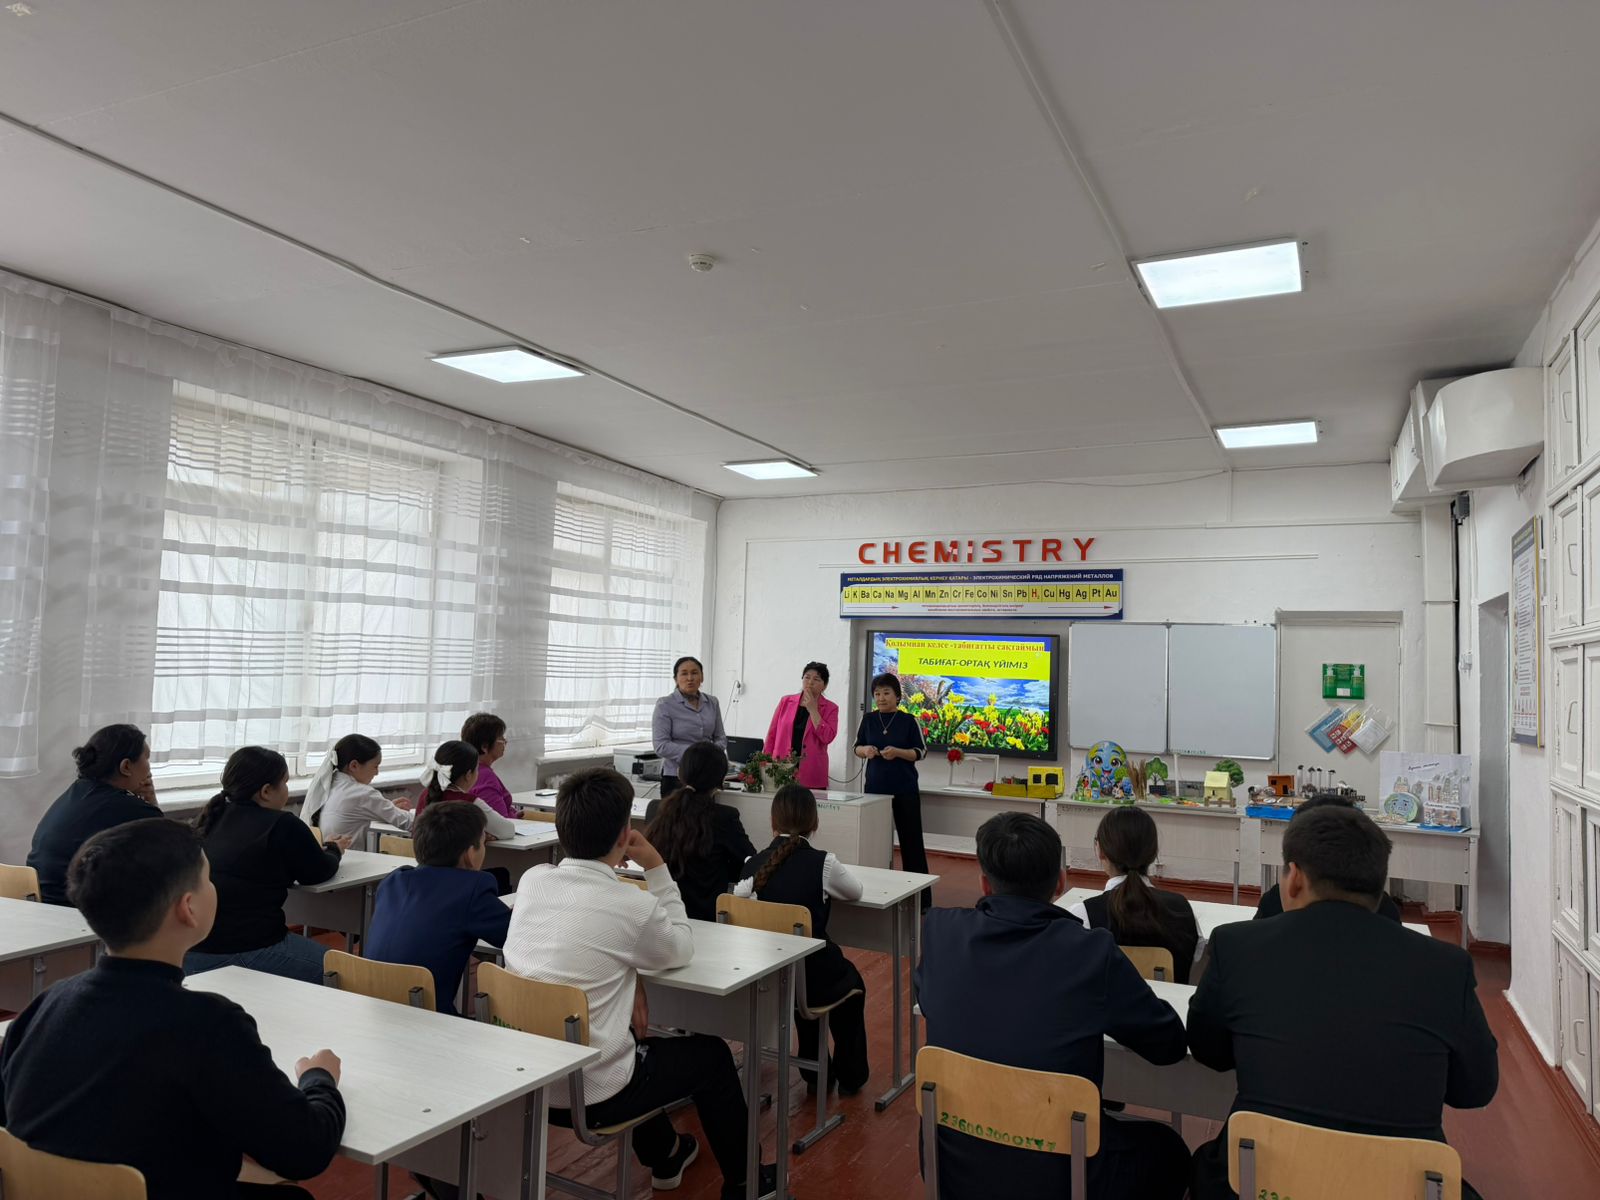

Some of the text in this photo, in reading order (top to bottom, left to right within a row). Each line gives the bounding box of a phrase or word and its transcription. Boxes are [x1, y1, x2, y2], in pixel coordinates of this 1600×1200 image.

[858, 537, 1095, 564] CHEMISTRY
[885, 590, 894, 598] Na
[898, 590, 908, 600] Mg
[913, 590, 920, 598] Al
[925, 590, 936, 598] Mn
[939, 590, 949, 598] Zn
[953, 590, 961, 598] Cr
[965, 590, 974, 598] Fe
[977, 590, 987, 598] Co
[1017, 589, 1027, 598] Pb
[1044, 589, 1054, 598] Cu
[1059, 589, 1070, 599] Hg
[1076, 589, 1087, 599] Ag
[1092, 589, 1101, 597] Pt
[1105, 589, 1117, 597] Au
[918, 658, 1028, 669] ТАБИҒАТ-ОРТАҚ ҮЙІМІЗ
